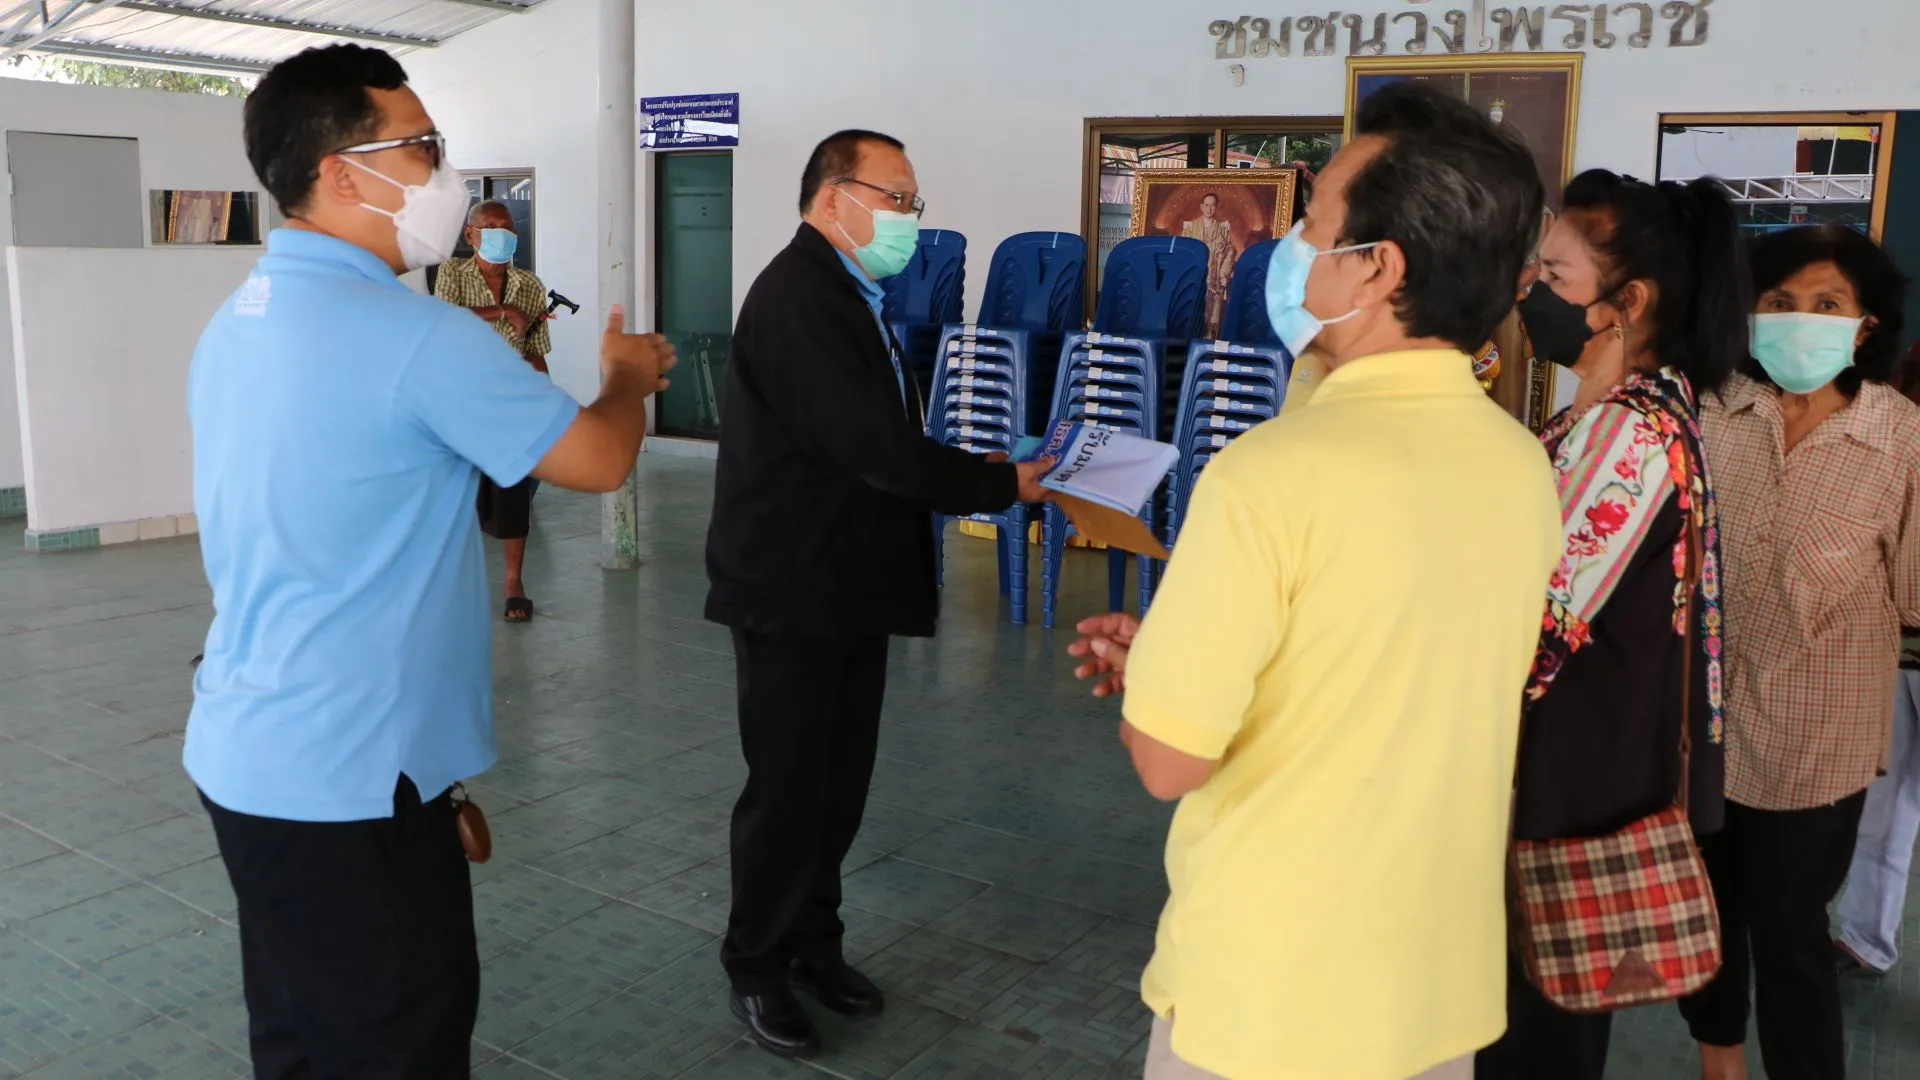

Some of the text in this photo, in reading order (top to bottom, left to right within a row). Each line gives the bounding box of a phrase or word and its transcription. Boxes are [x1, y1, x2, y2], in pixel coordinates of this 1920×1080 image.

[1208, 0, 1714, 87] ชุมชนวงไพรเวช
